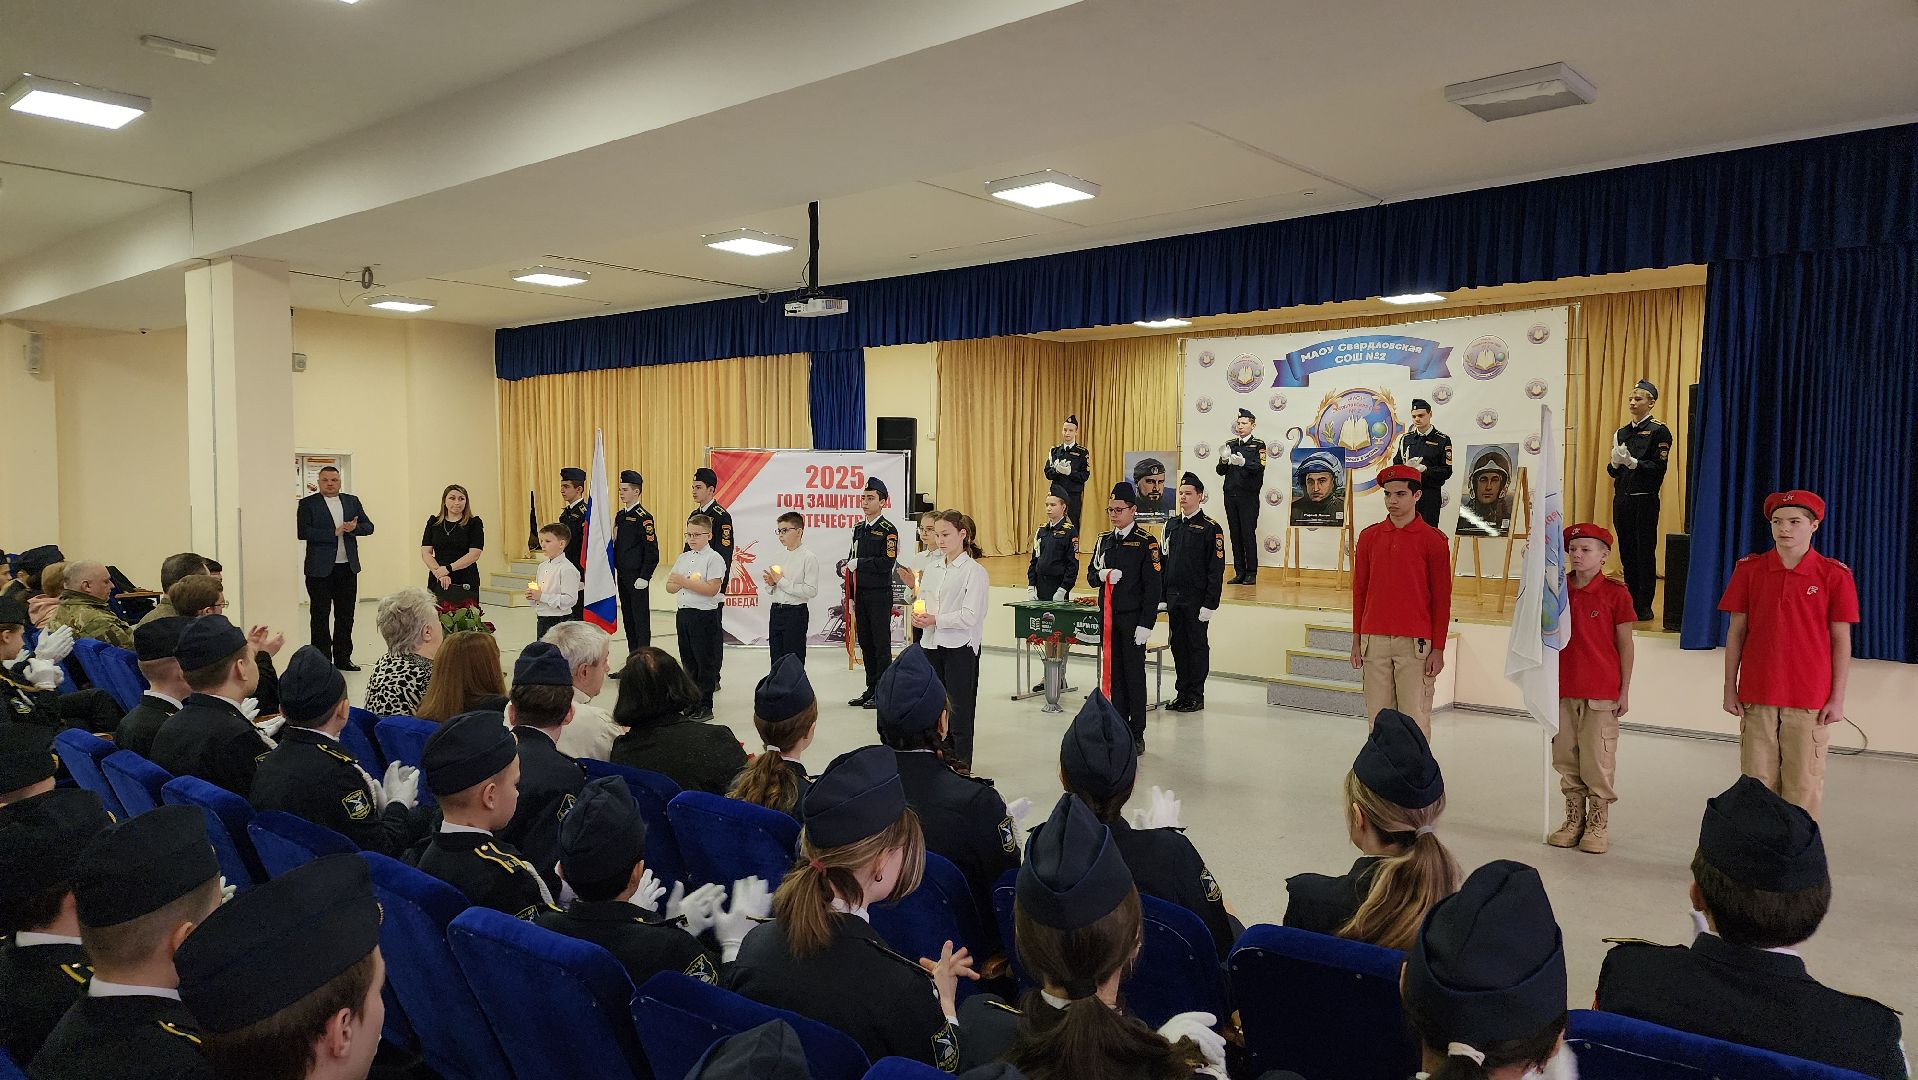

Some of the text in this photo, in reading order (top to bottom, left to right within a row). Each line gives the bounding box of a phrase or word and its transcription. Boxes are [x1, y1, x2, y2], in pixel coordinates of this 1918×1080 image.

[1301, 342, 1423, 362] МАОУ Свердловская
[1334, 351, 1387, 364] СОШ №2
[805, 464, 865, 490] 2025
[777, 493, 892, 510] ГОД ЗАЩИТНА
[725, 597, 759, 608] ОБЕДА!
